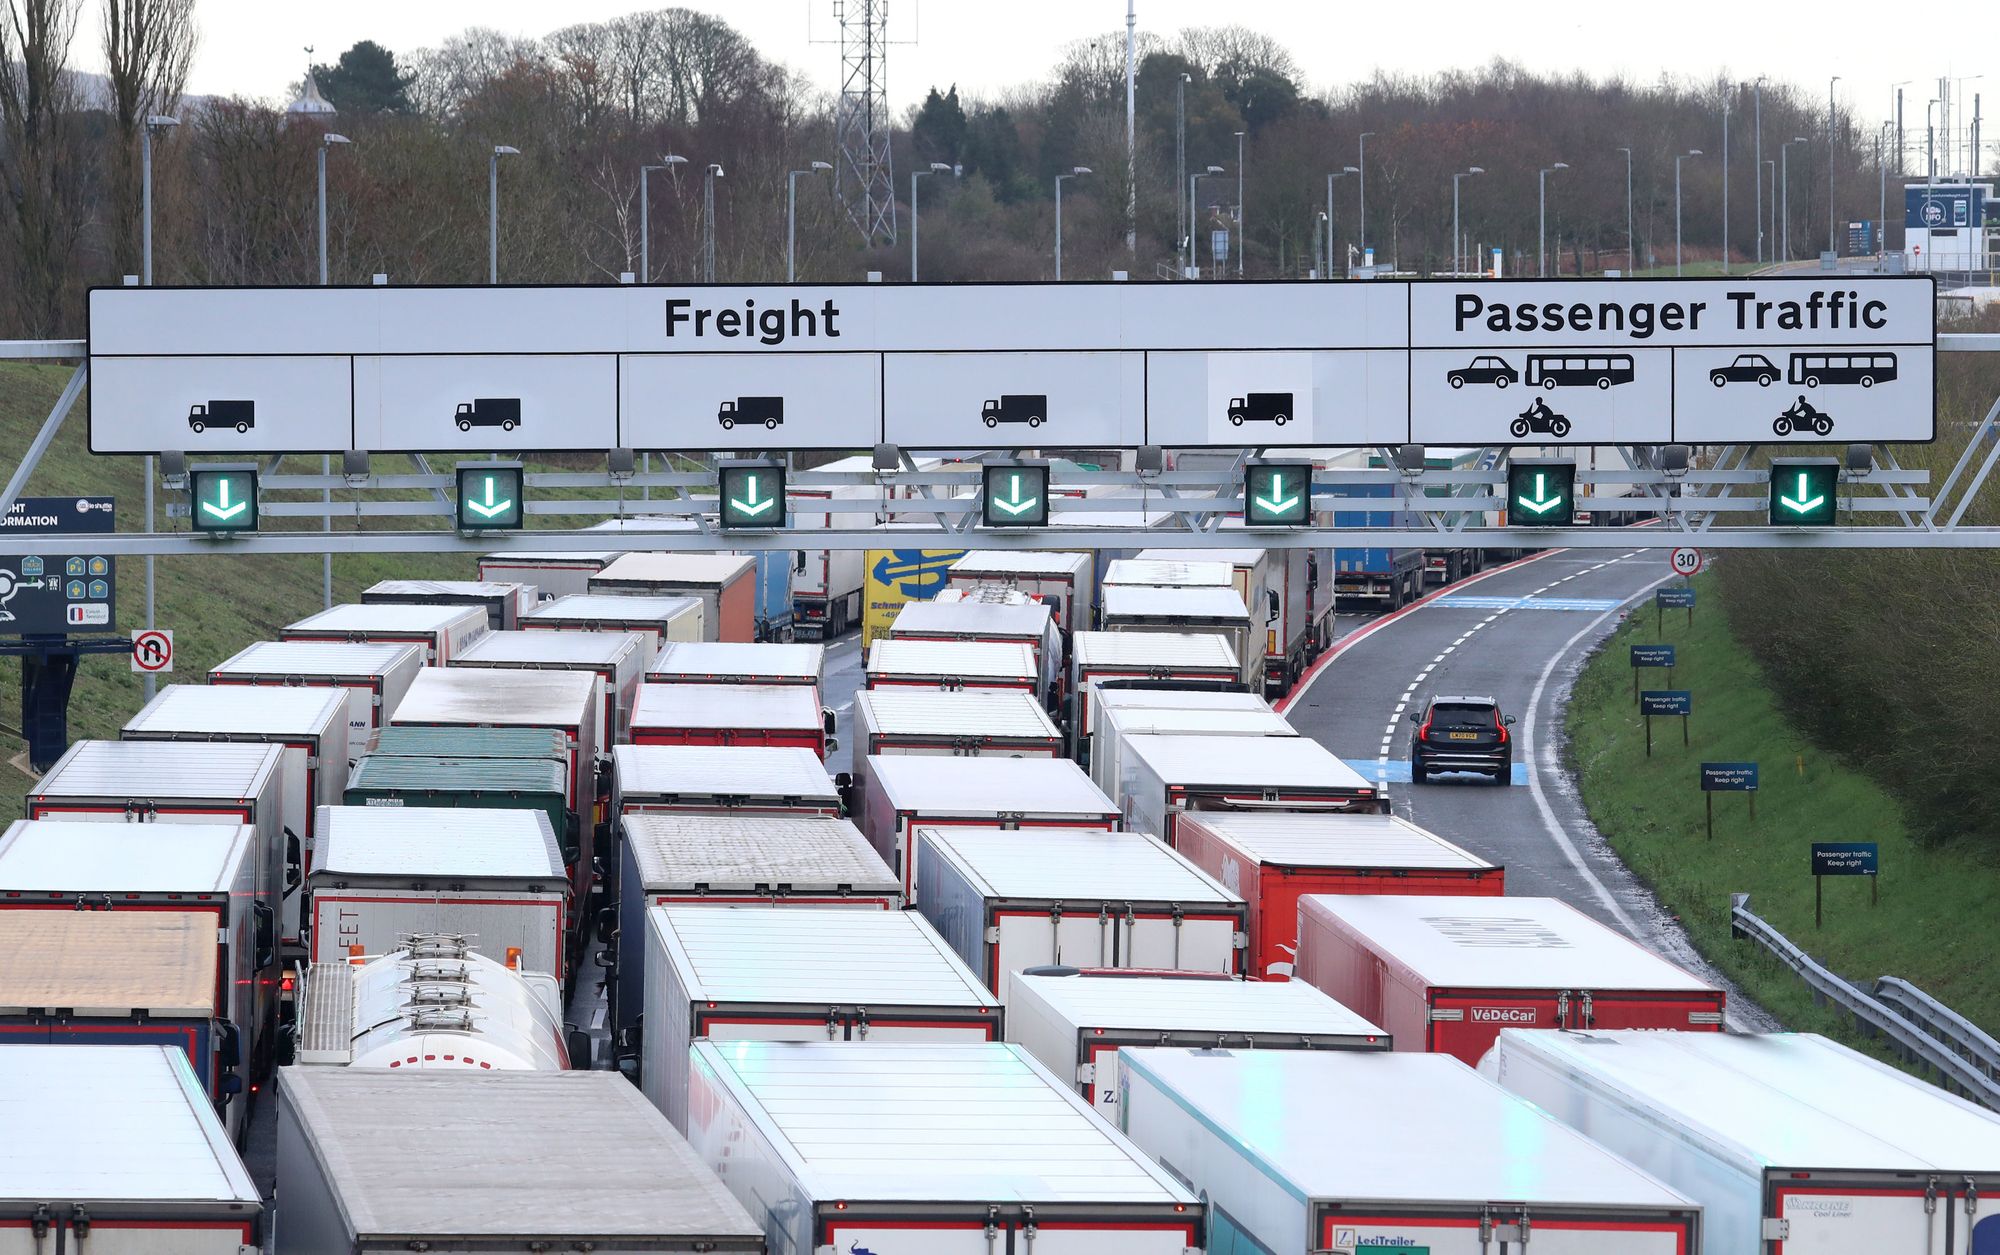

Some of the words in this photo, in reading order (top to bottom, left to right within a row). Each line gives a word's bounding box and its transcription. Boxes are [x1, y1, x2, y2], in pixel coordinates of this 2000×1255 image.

[1455, 294, 1707, 339] Passenger
[1726, 291, 1888, 330] Traffic
[665, 299, 841, 346] Freight
[1677, 553, 1696, 567] 30
[1816, 851, 1852, 859] Passenger
[1846, 860, 1862, 868] right
[1473, 1009, 1535, 1021] VéDéCar
[1813, 1210, 1831, 1218] Cool
[1832, 1210, 1851, 1218] Liner
[1357, 1234, 1416, 1247] LeciTrailer
